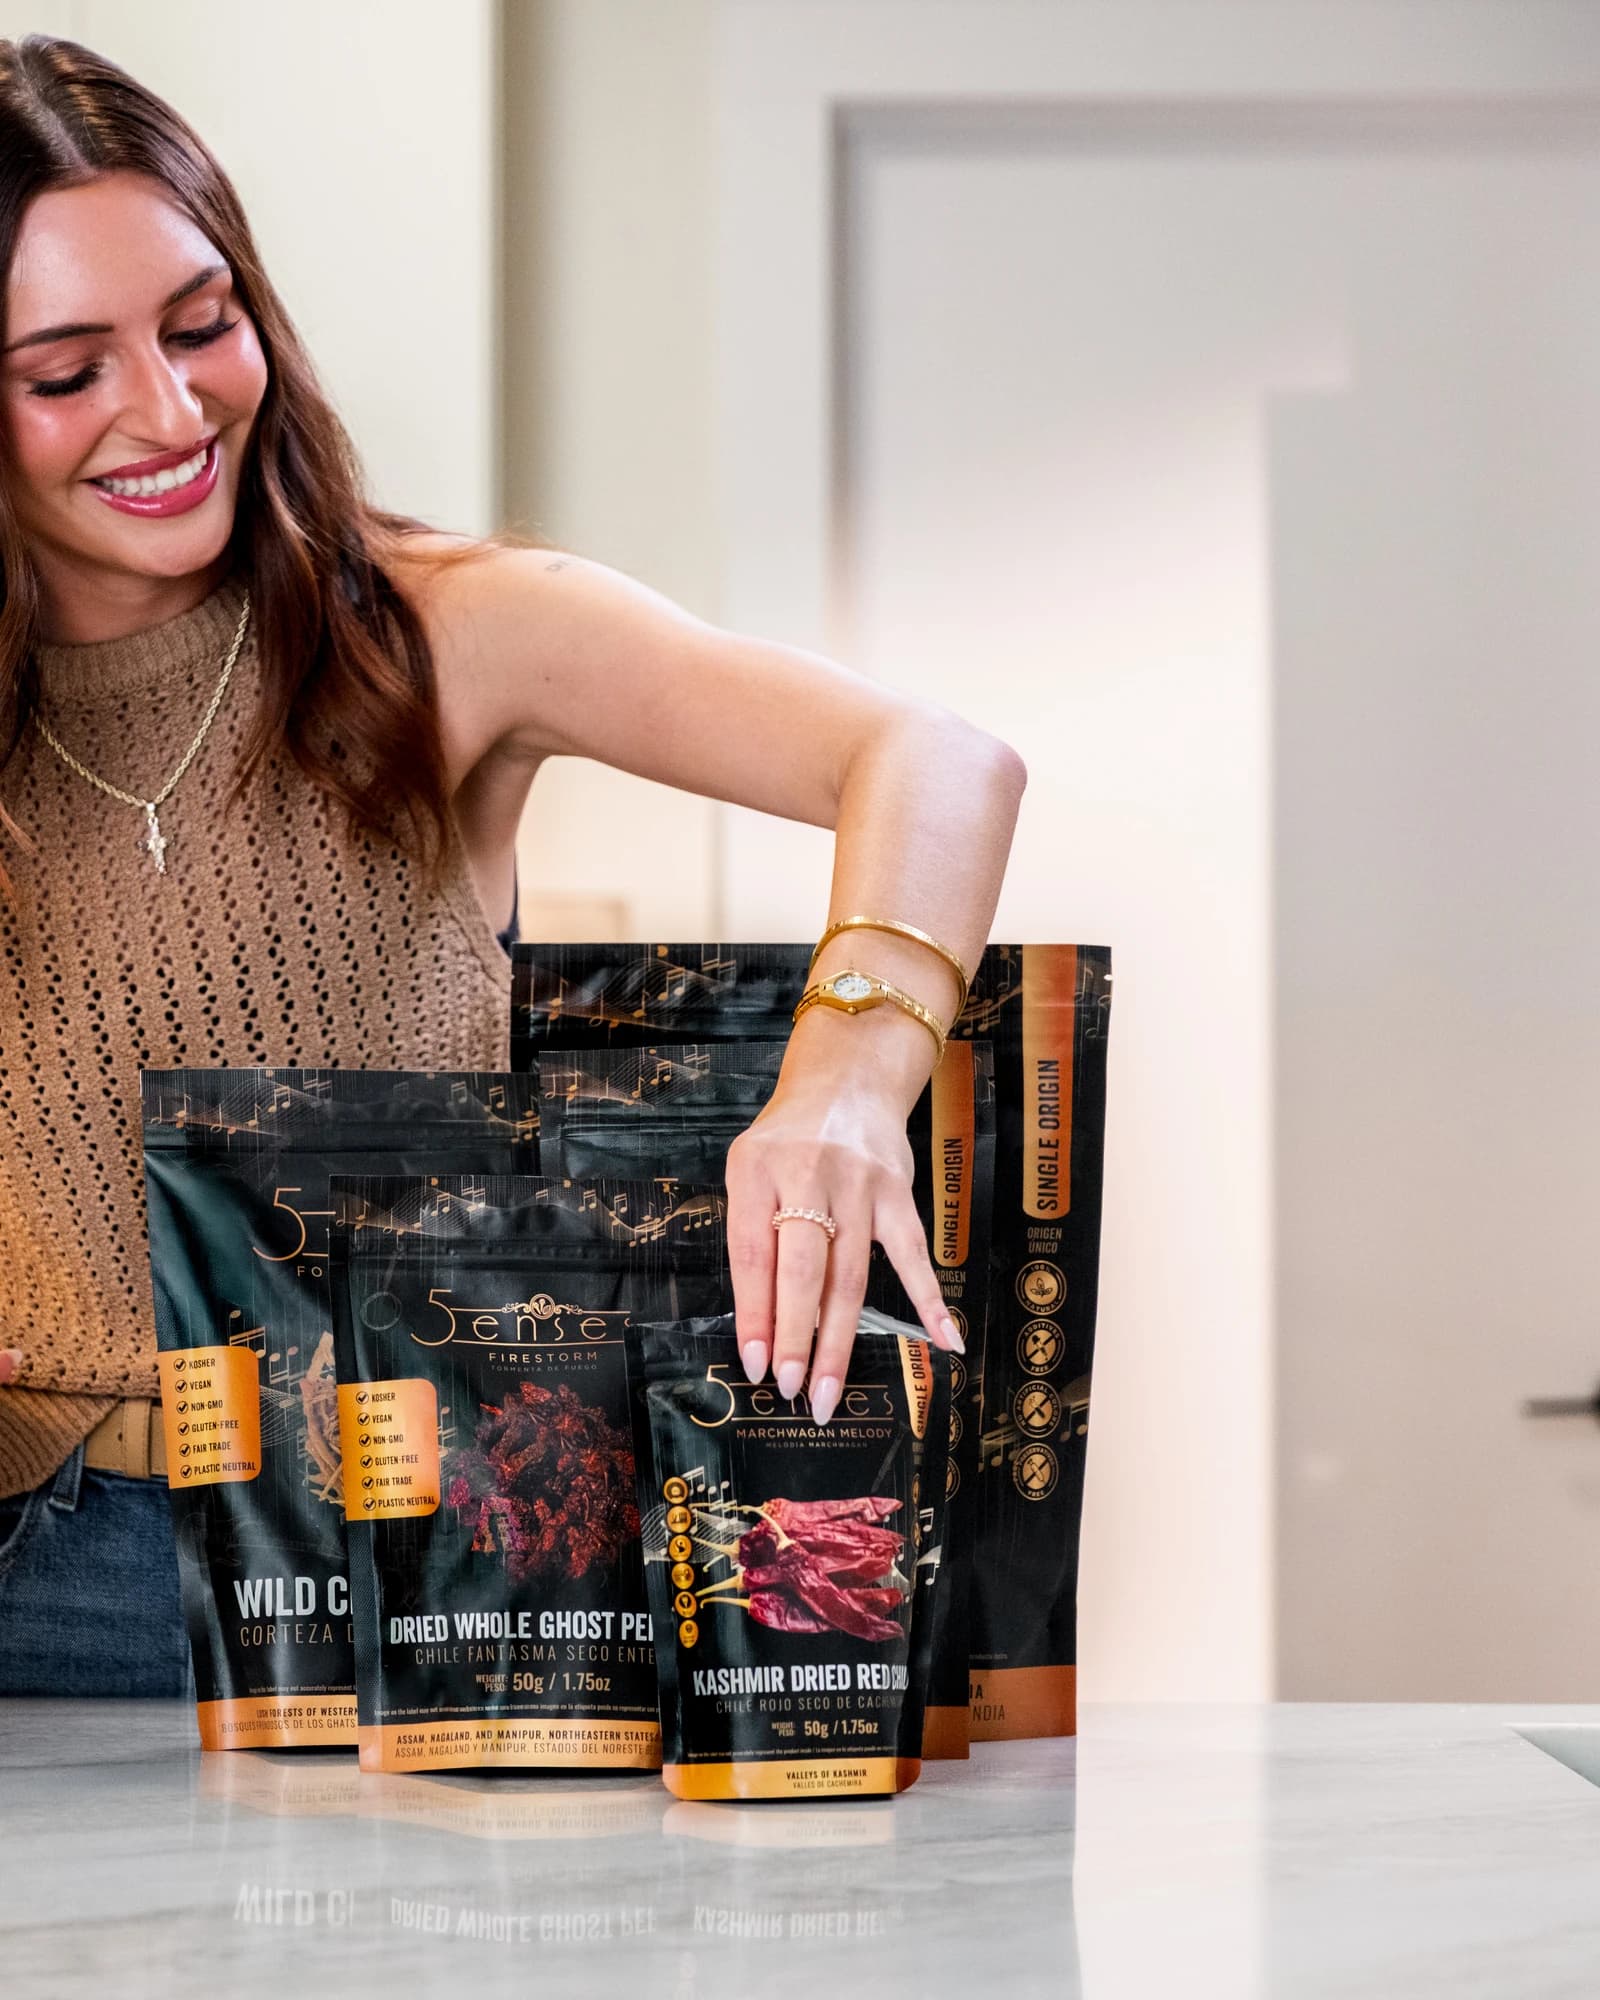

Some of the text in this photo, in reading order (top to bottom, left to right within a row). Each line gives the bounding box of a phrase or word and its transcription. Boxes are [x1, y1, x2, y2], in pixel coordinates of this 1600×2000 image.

[1037, 1060, 1060, 1211] SINGLE ORIGIN
[943, 1138, 962, 1260] SINGLE ORIGIN
[253, 1187, 306, 1262] 5
[1027, 1226, 1063, 1240] ORIGEN
[297, 1266, 323, 1277] FO
[189, 1358, 216, 1370] KOSHER
[488, 1352, 597, 1364] FIRESTORM
[189, 1379, 212, 1391] VEGAN
[371, 1392, 396, 1403] KOSHER
[690, 1364, 894, 1428] 5enes
[191, 1400, 224, 1412] NON-GMO
[914, 1384, 928, 1433] SINGLE
[372, 1414, 393, 1424] VEGAN
[191, 1420, 240, 1433] GLUTEN-FREE
[736, 1427, 893, 1439] MARCHWAGAN MELODY
[373, 1434, 404, 1445] NON-GMO
[192, 1441, 232, 1454] FAIR TRADE
[375, 1454, 419, 1466] GLUTEN-FREE
[194, 1461, 256, 1476] PLASTIC NEUTRAL
[375, 1475, 413, 1488] FAIR TRADE
[378, 1495, 436, 1509] PLASTIC NEUTRAL
[233, 1575, 354, 1620] WILD C
[390, 1614, 449, 1645] DRIED
[453, 1611, 532, 1640] WHOLE
[539, 1610, 615, 1640] GHOST
[240, 1623, 334, 1647] CORTEZA
[415, 1644, 655, 1665] CHILE FANTASMA SECO ENTE
[512, 1672, 611, 1694] 50g / 1.75oz
[692, 1665, 785, 1696] KASHMIR
[790, 1663, 851, 1692] DRIED
[856, 1663, 891, 1690] RED
[716, 1699, 752, 1714] CHILE
[759, 1698, 792, 1712] ROJO
[798, 1696, 831, 1711] SECO
[837, 1696, 851, 1710] DE
[269, 1707, 304, 1718] FORESTS
[306, 1707, 317, 1717] OF
[972, 1704, 1006, 1721] NDIA
[293, 1719, 305, 1729] DE
[307, 1719, 324, 1729] LOS
[326, 1718, 356, 1729] GHATS
[803, 1718, 879, 1739] 50g / 1.75oz
[396, 1734, 428, 1745] ASSAM,
[430, 1731, 473, 1743] NAGALAND,
[475, 1730, 493, 1740] AND
[497, 1729, 545, 1741] MANIPUR,
[549, 1730, 621, 1741] NORTHEASTERN
[395, 1747, 426, 1759] ASSAM,
[428, 1743, 470, 1756] NAGALAND
[472, 1743, 478, 1752] Y
[481, 1742, 531, 1754] MANIPUR,
[534, 1742, 578, 1754] ESTADOS
[581, 1743, 598, 1754] DEL
[602, 1743, 645, 1755] NORESTE
[786, 1768, 868, 1781] VALLEYS OF KASHMIR
[793, 1780, 816, 1790] VALLES
[816, 1780, 825, 1788] DE
